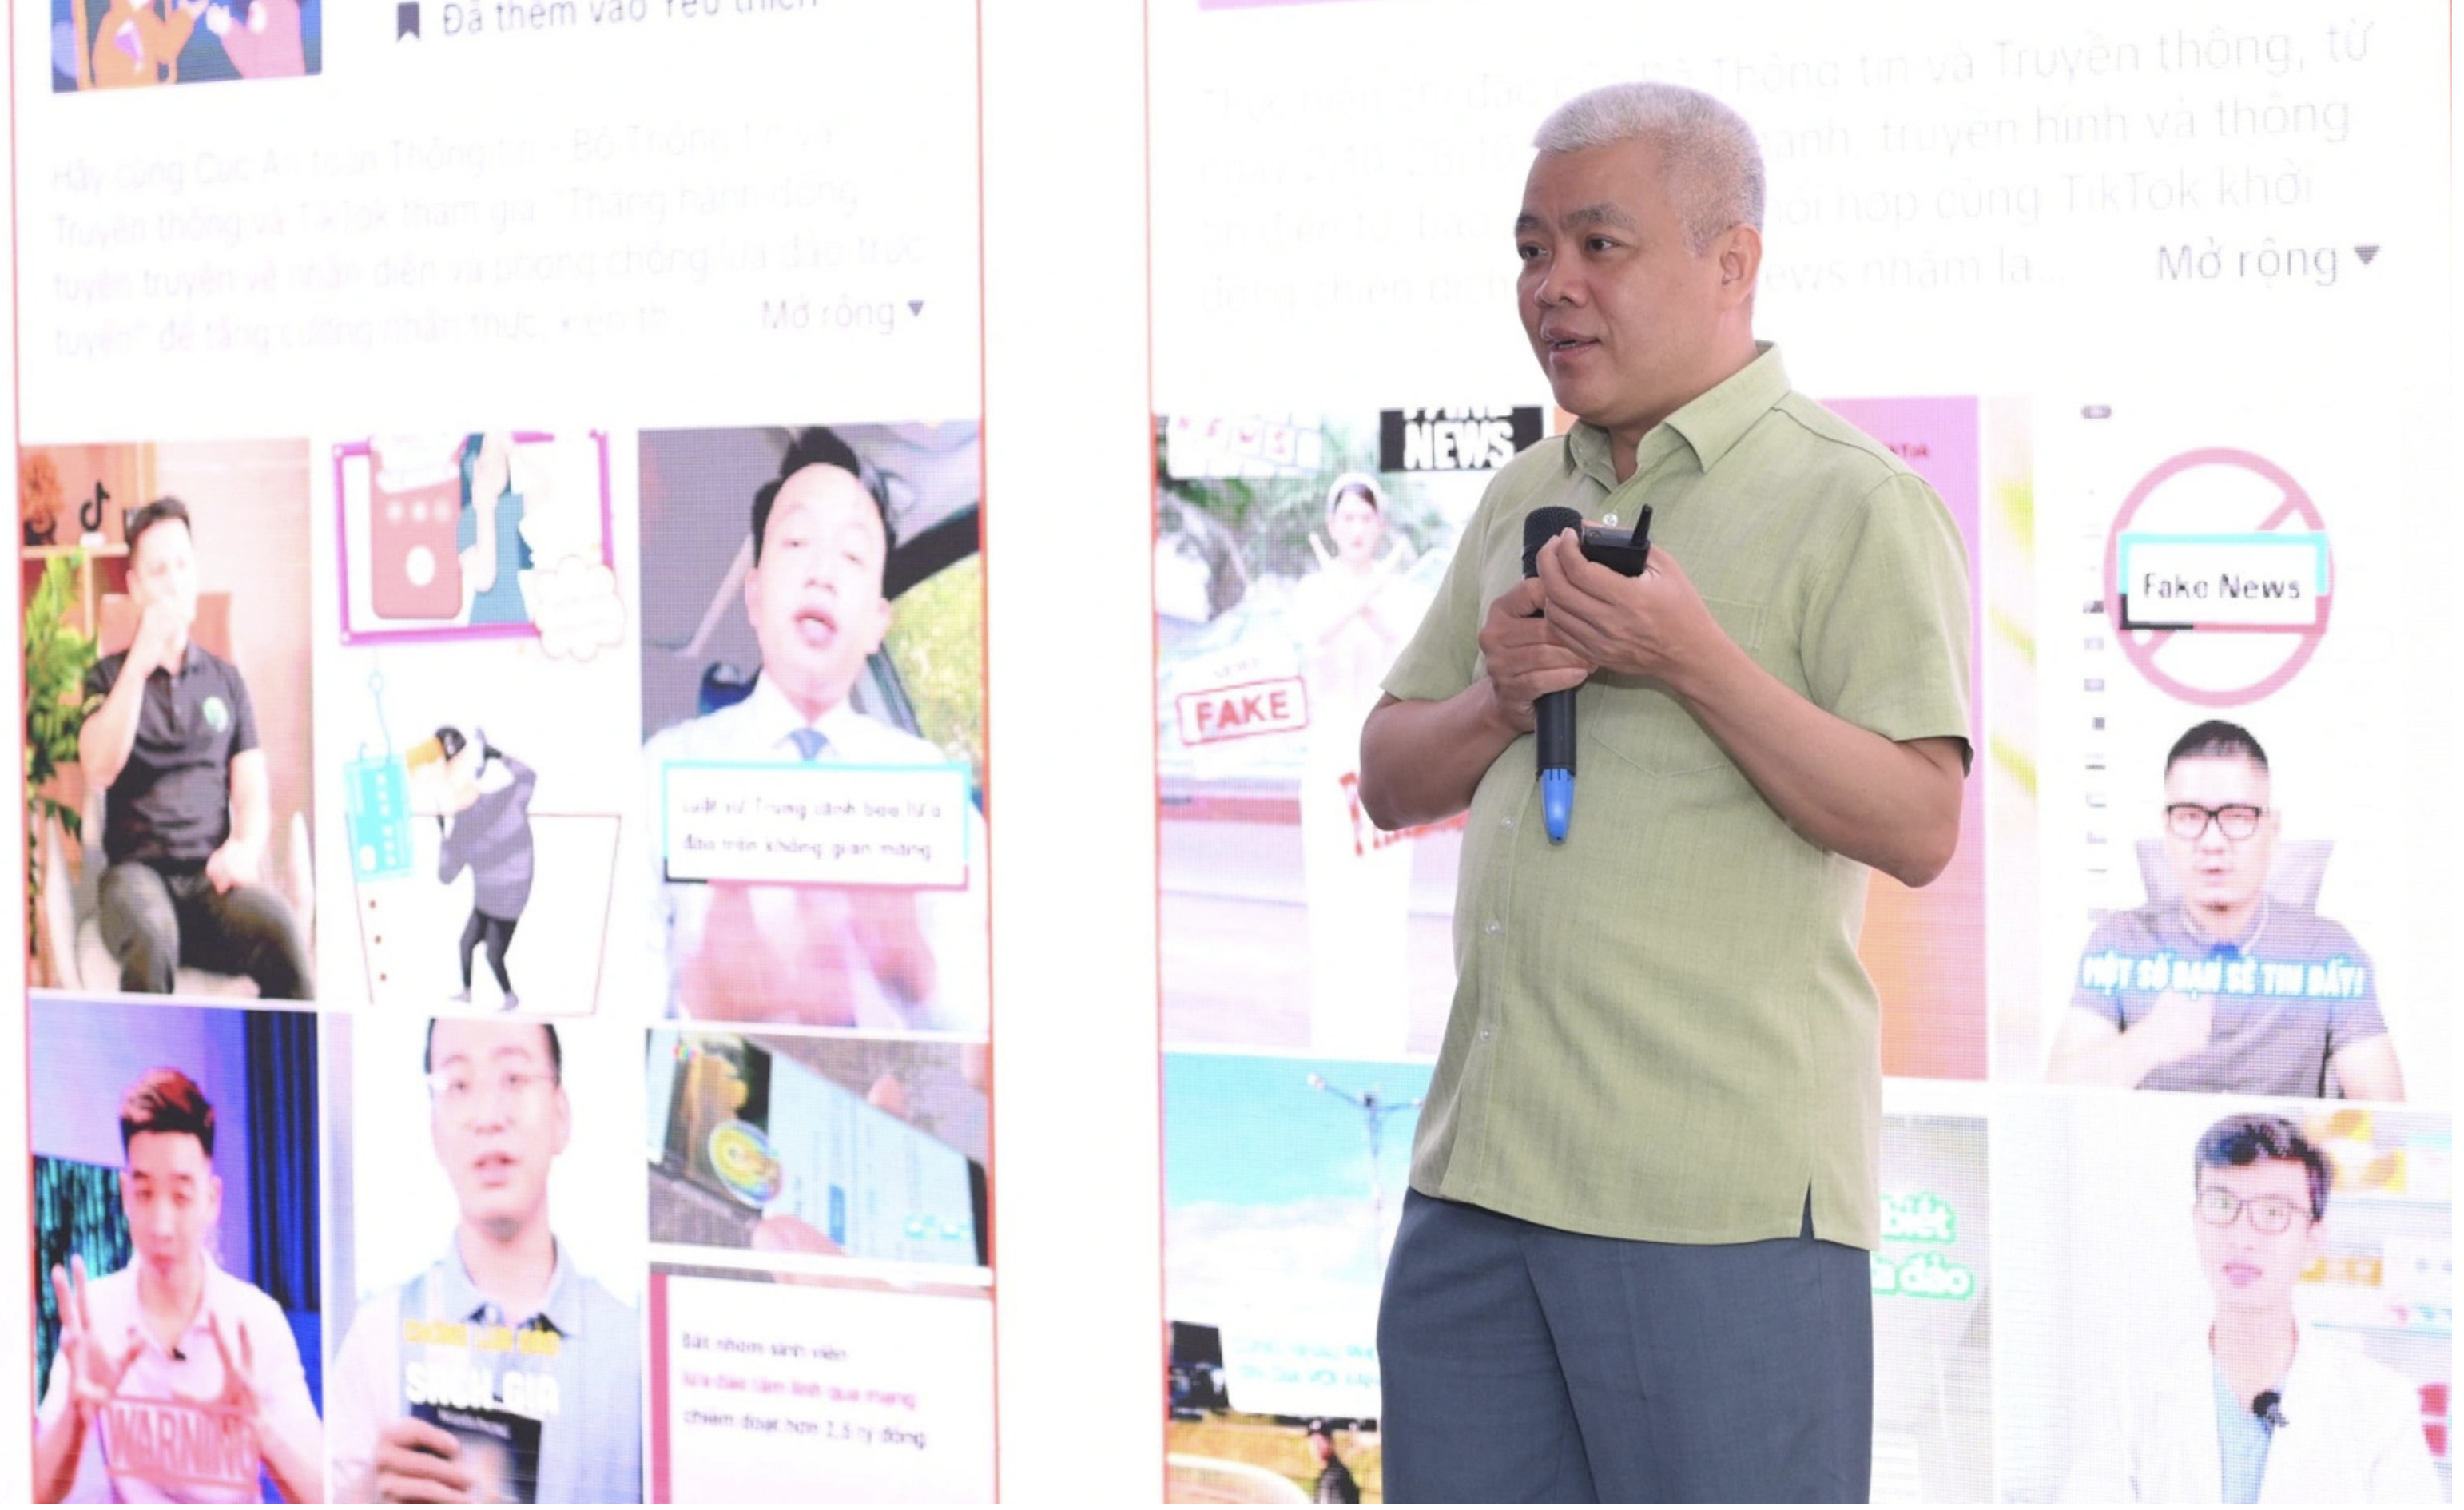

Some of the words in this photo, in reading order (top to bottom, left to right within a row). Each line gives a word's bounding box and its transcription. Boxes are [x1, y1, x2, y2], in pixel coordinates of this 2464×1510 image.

[1993, 30, 2140, 85] Truyền
[2156, 24, 2304, 77] thông,
[2327, 17, 2374, 62] từ
[2145, 93, 2195, 139] và
[2216, 89, 2351, 144] thông
[1935, 175, 2041, 227] cùng
[2061, 167, 2200, 213] TikTok
[2218, 157, 2314, 206] khởi
[2156, 236, 2223, 280] Mở
[2239, 236, 2338, 289] rộng
[761, 292, 811, 330] Mở
[822, 291, 896, 336] rộng
[1404, 419, 1516, 471] NEWS
[2143, 572, 2208, 599] Fake
[2220, 572, 2302, 600] News
[1196, 689, 1291, 733] FAKE
[107, 1406, 255, 1486] WARNING
